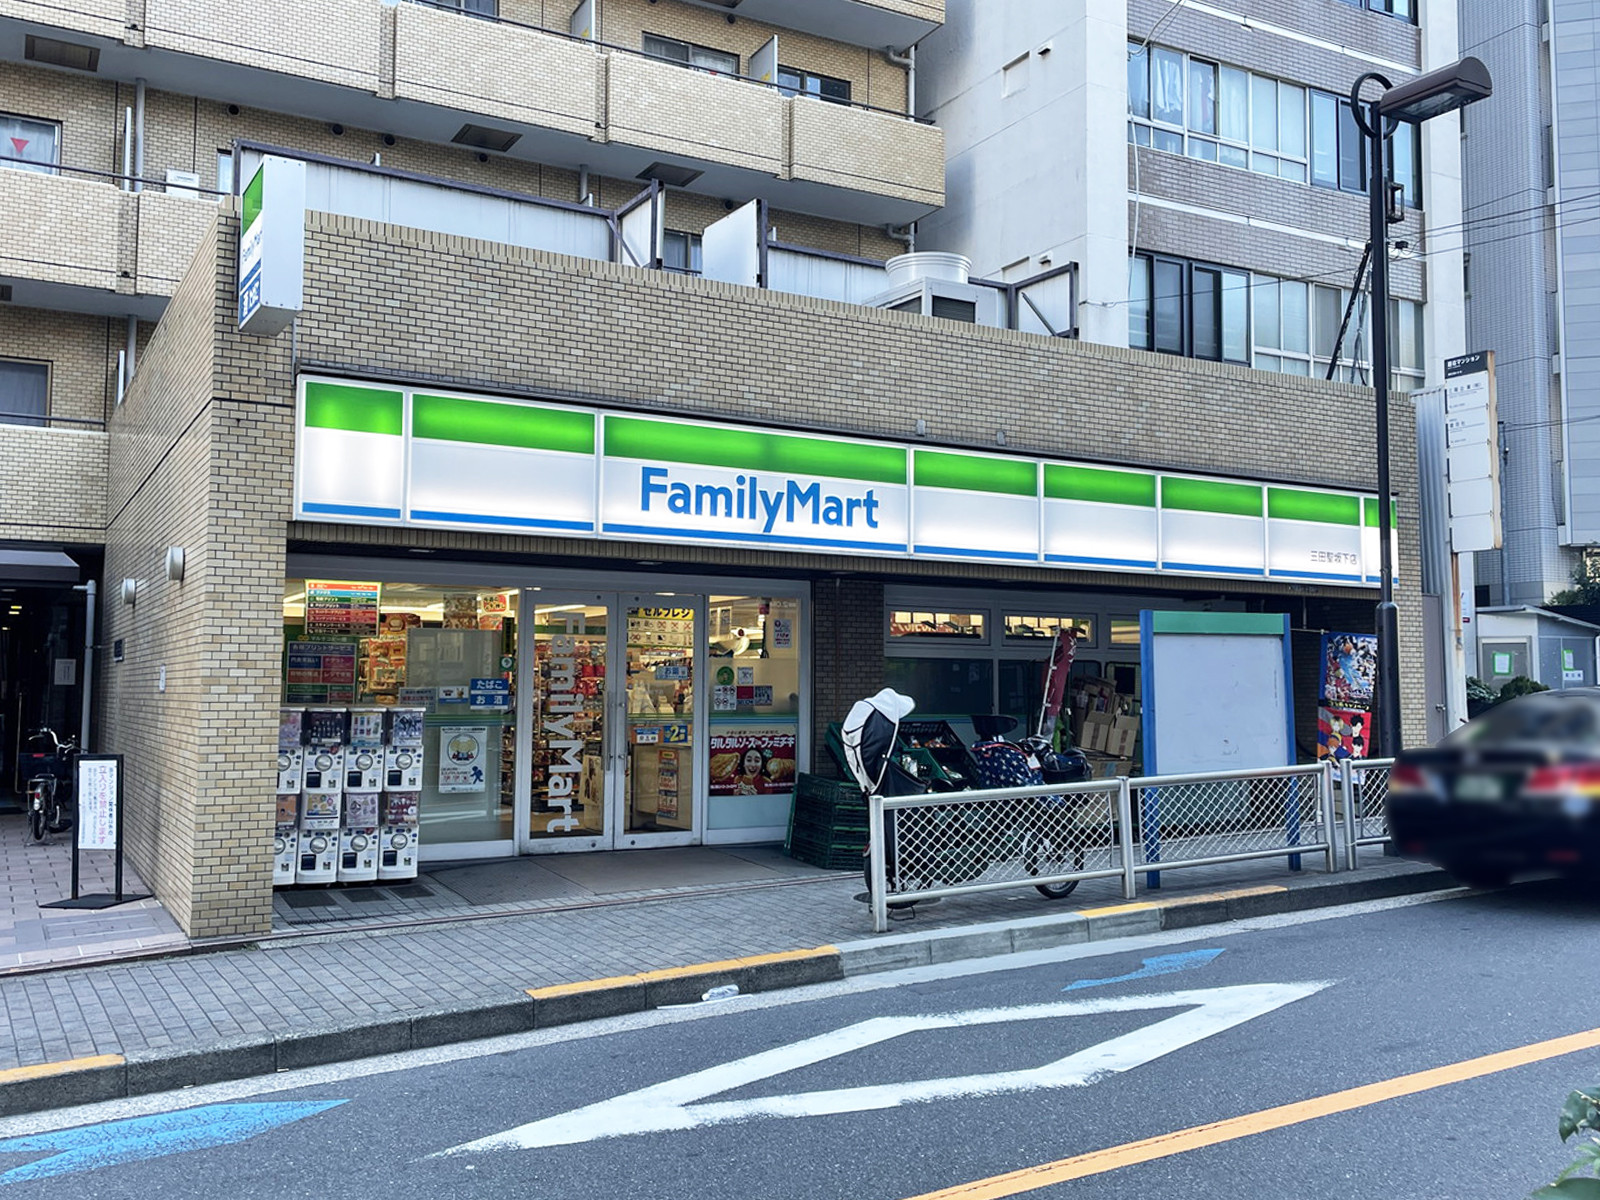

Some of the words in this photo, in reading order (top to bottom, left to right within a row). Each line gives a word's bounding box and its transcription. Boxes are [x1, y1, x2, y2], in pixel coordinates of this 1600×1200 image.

[641, 466, 879, 533] FamilyMart
[643, 608, 690, 617] セルフレジ
[476, 680, 503, 690] たばこ
[544, 612, 586, 833] FamilyMart
[98, 765, 107, 845] 立入りを禁止します
